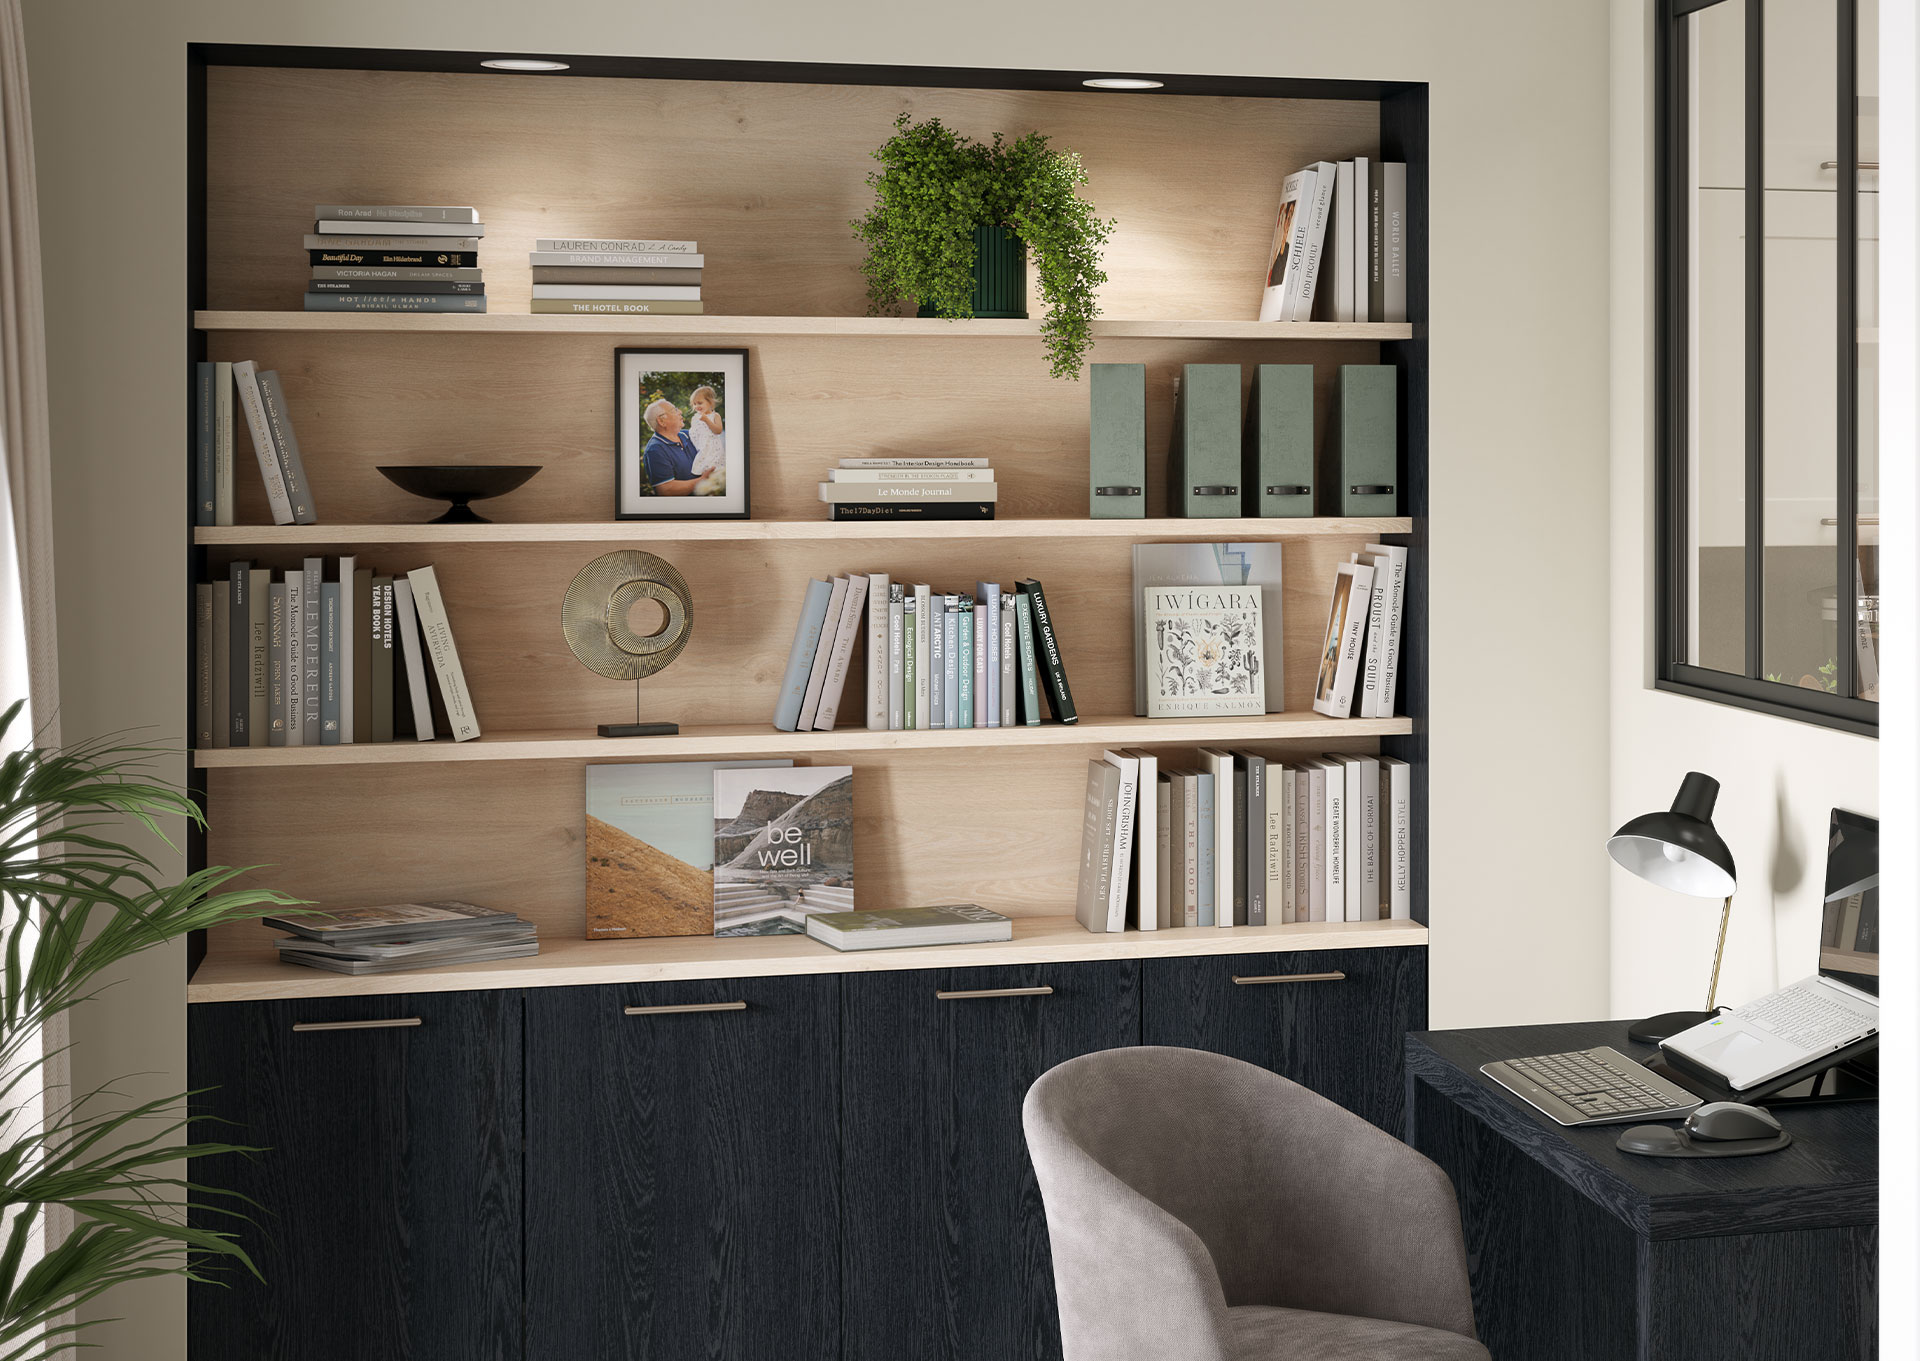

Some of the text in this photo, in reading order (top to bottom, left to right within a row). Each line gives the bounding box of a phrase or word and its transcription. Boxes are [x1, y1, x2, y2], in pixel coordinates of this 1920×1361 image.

[355, 209, 372, 217] Arad
[350, 254, 363, 262] Day
[553, 241, 597, 250] LAUREN
[600, 242, 646, 251] CONRAD
[1292, 226, 1306, 270] SCHIELE
[1392, 211, 1400, 277] WORLD BALLET
[604, 256, 668, 264] MANAGEMENT
[1305, 242, 1318, 278] PICOULT
[401, 296, 437, 304] HANDS
[1302, 280, 1312, 299] JODI
[572, 304, 589, 312] THE
[592, 304, 621, 312] HOTEL
[878, 488, 952, 496] Le Monde Journal
[1394, 562, 1402, 578] The
[290, 587, 298, 603] The
[372, 586, 380, 608] YEAR
[1155, 590, 1258, 610] IWÍGARA
[1371, 588, 1383, 629] PROUST
[1391, 579, 1402, 613] Monocle
[272, 597, 283, 647] SAVANNAH
[290, 605, 298, 637] Monocle
[372, 609, 380, 632] BOOK
[1022, 603, 1030, 640] EXECUTIVE
[1033, 592, 1048, 624] LUXURY
[1043, 626, 1059, 666] GARDENS
[1389, 614, 1398, 637] Guide
[428, 624, 445, 668] AYURVEDA
[436, 621, 450, 652] LIVING
[840, 638, 849, 653] THE
[976, 618, 984, 674] LUXURY FOR CATS
[1347, 621, 1360, 661] TINY HOUSE
[254, 622, 265, 698] Lee Radziwill
[290, 640, 298, 662] Guide
[306, 600, 318, 723] LEMPEREUR
[905, 627, 913, 682] Ecological Design
[1025, 641, 1033, 672] ESCAPES
[1386, 648, 1395, 670] Good
[833, 656, 844, 683] AWARD
[946, 652, 955, 680] Design
[1365, 658, 1377, 691] SQUID
[290, 674, 298, 695] Good
[961, 679, 969, 701] Design
[1383, 672, 1393, 704] Business
[290, 698, 298, 730] Business
[1158, 702, 1209, 711] ENRIQUE
[1119, 782, 1133, 850] JOHN GRISHAM
[768, 820, 802, 845] be
[1269, 812, 1278, 881] Lee Radziwill
[1298, 795, 1307, 894] CLASSIC IRISH STORIES
[1367, 830, 1373, 841] OF
[758, 842, 811, 867] well
[1101, 844, 1110, 882] PLAISIRS
